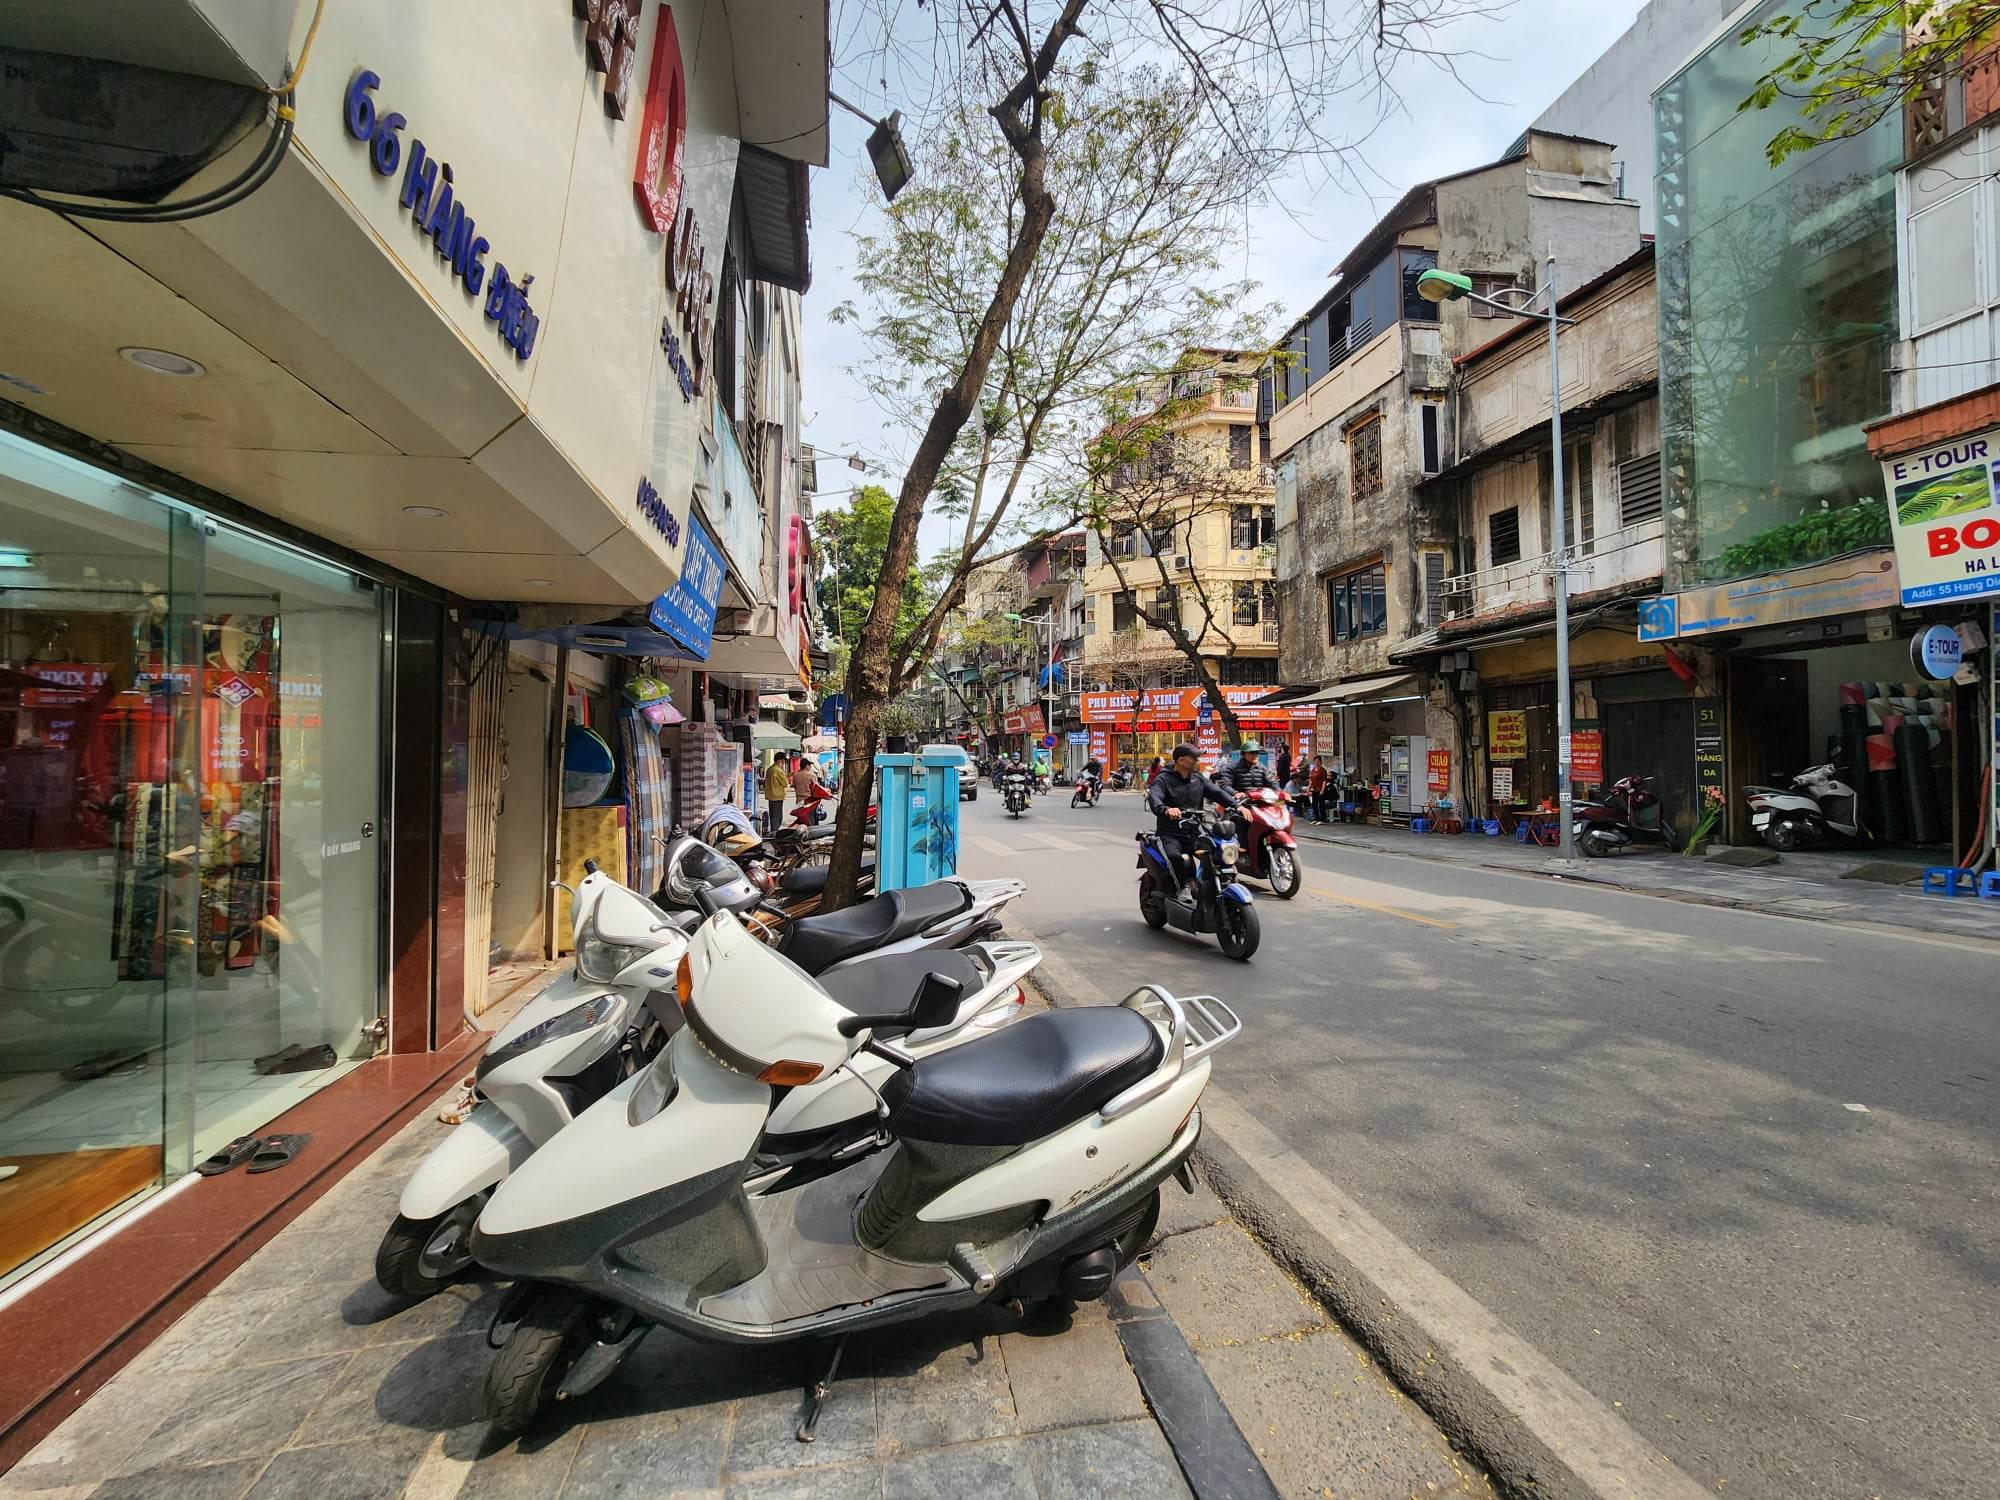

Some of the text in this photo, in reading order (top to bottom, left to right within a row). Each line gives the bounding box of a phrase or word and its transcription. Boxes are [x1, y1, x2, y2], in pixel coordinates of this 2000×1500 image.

[344, 71, 407, 177] 66
[400, 138, 490, 296] HÀNG
[1965, 558, 1987, 574] HA
[1911, 587, 1937, 600] Add:
[1938, 584, 1952, 595] 55
[1953, 581, 1984, 593] Hang
[1153, 693, 1180, 706] XINH
[1700, 709, 1714, 721] 51
[1703, 769, 1717, 777] DA
